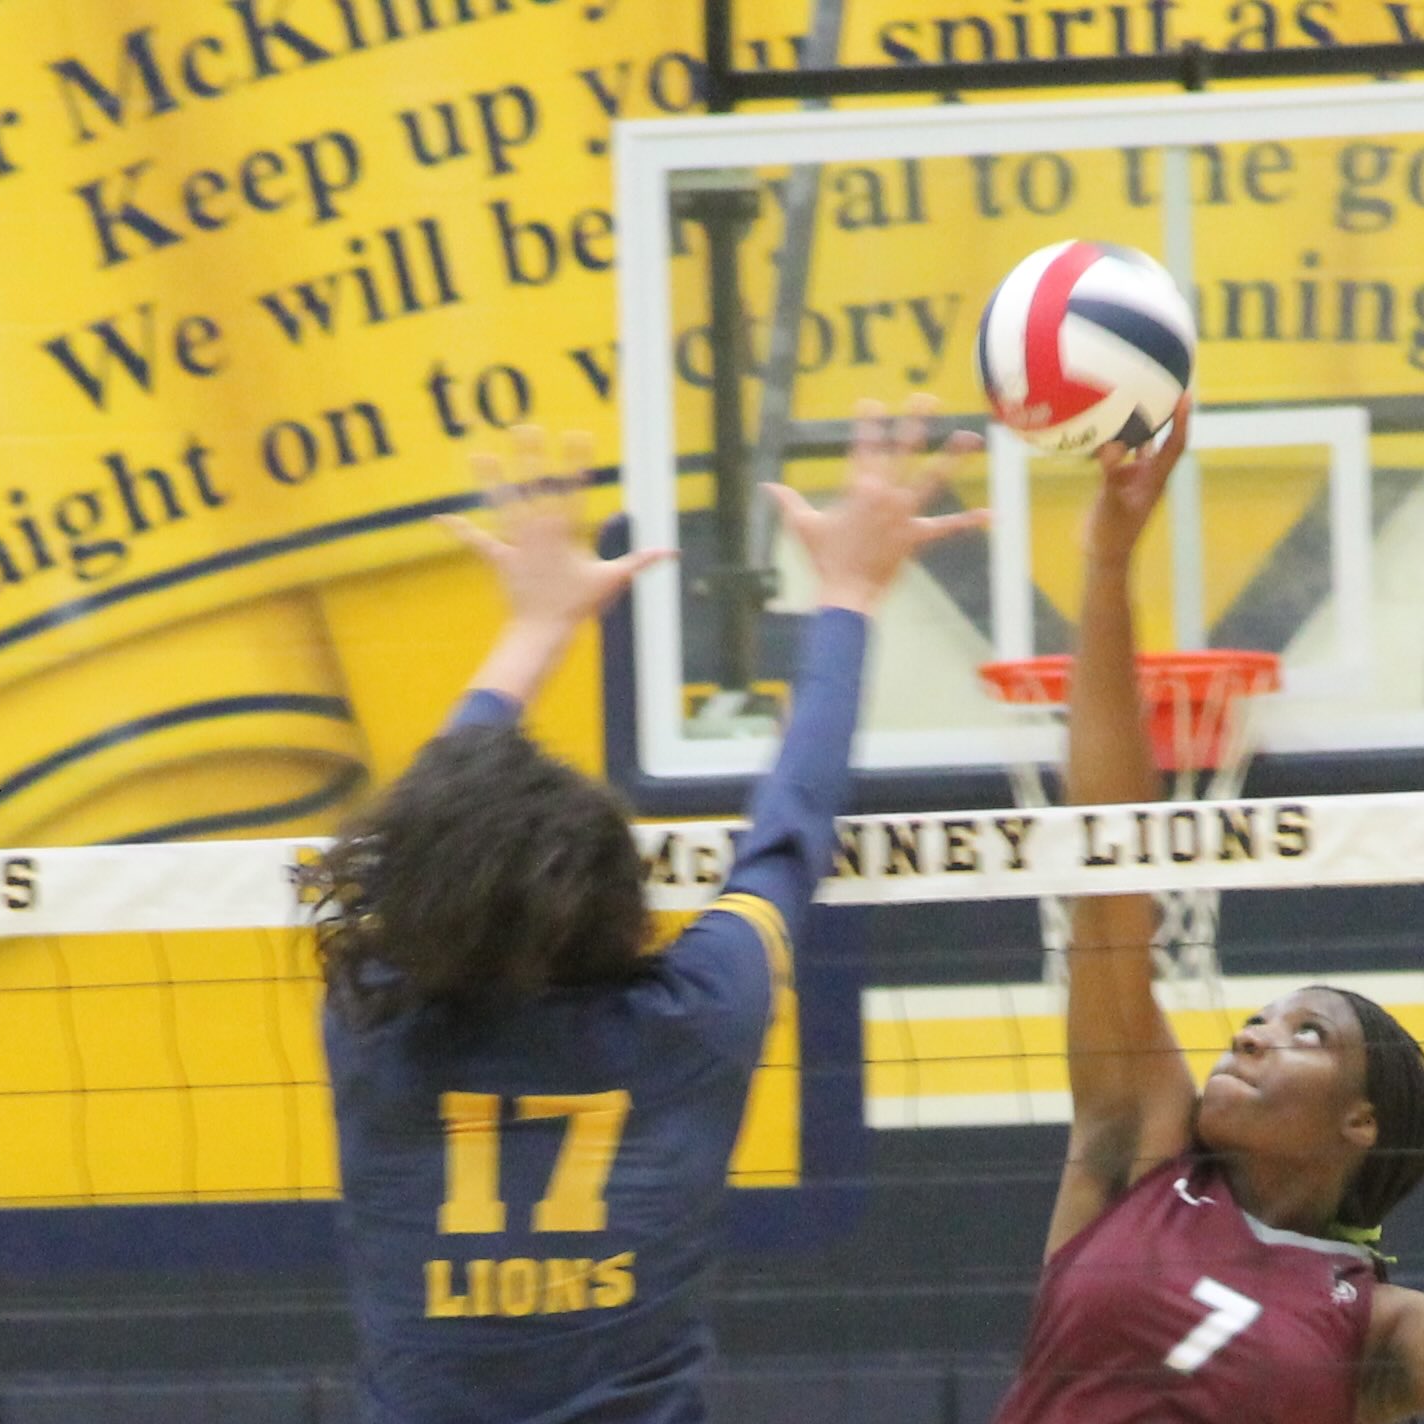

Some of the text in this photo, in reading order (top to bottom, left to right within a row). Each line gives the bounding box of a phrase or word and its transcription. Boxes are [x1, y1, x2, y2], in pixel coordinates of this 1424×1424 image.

[71, 130, 364, 271] Keep
[395, 83, 543, 178] up
[41, 302, 226, 412] We
[257, 214, 464, 346] will
[487, 200, 619, 288] be
[968, 150, 1076, 219] to
[261, 400, 397, 487] on
[424, 360, 534, 439] to
[1080, 803, 1314, 867] LIONS
[436, 1089, 634, 1234] 17
[423, 1252, 638, 1318] LIONS
[1163, 1276, 1264, 1374] 7
